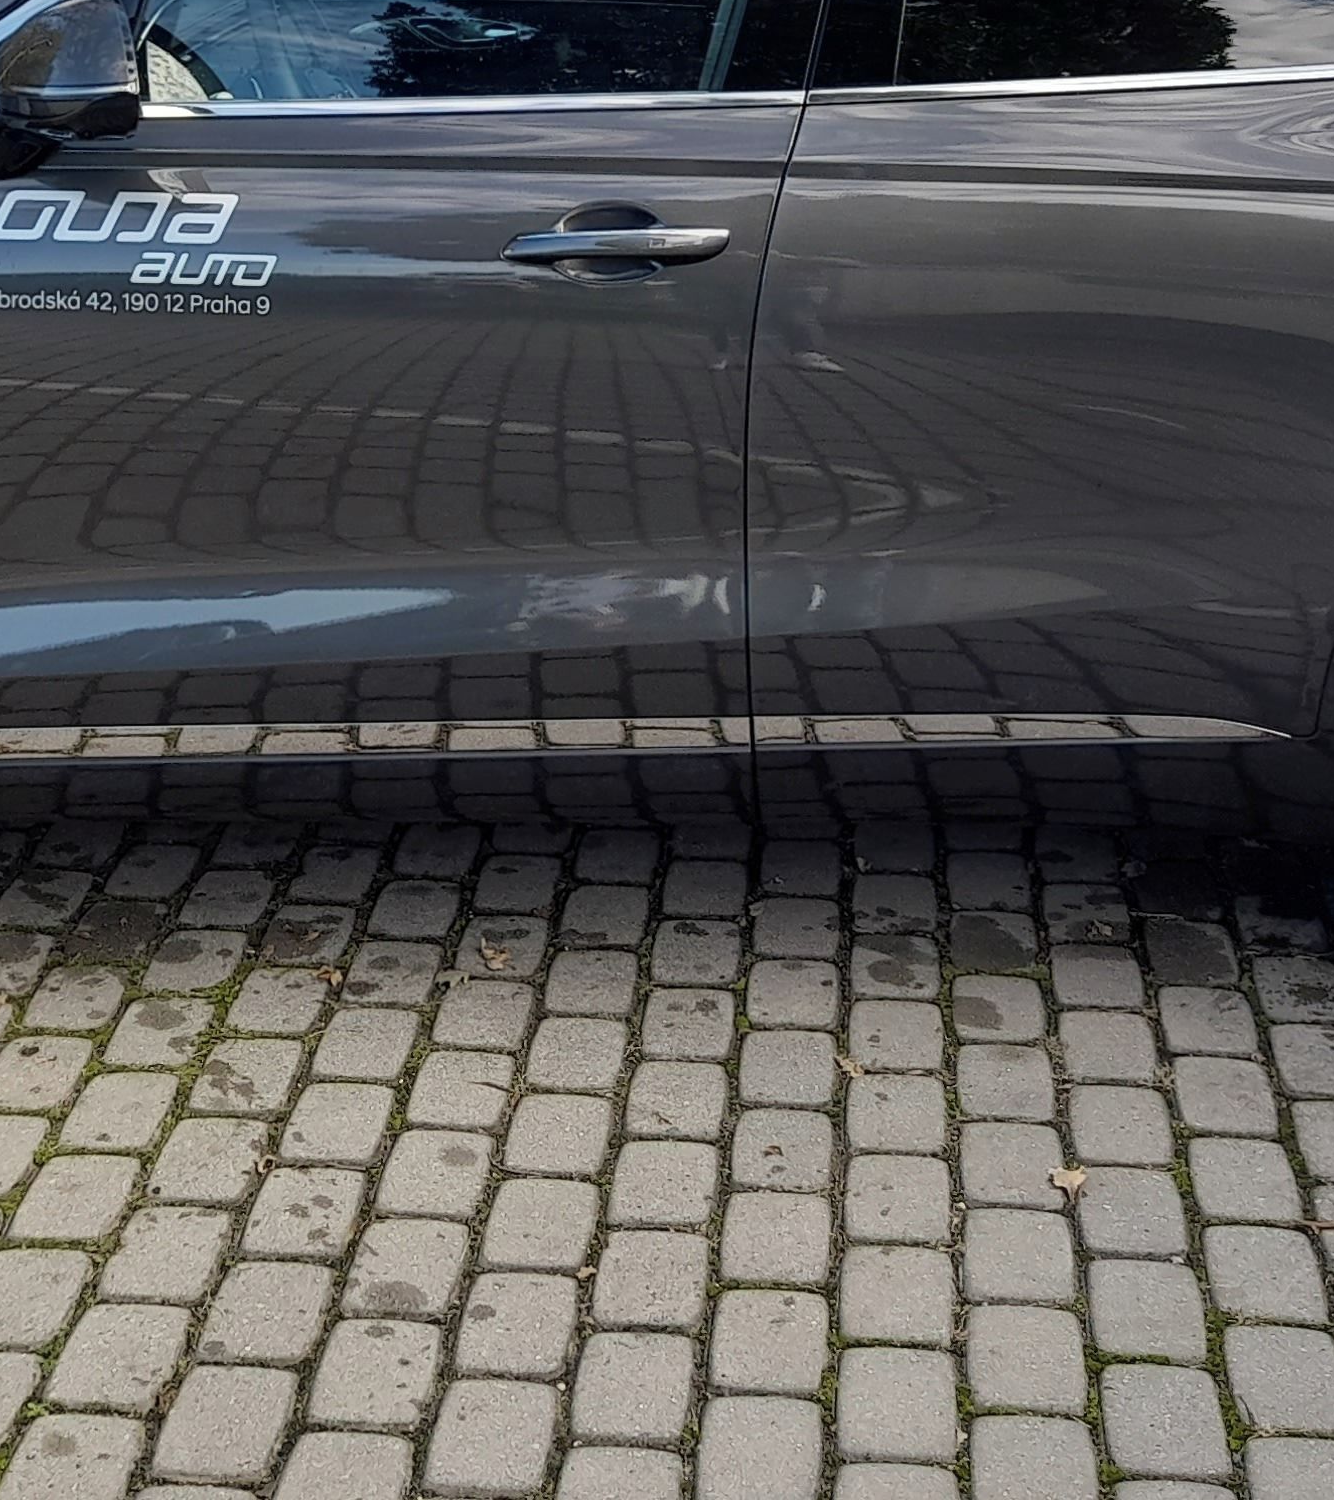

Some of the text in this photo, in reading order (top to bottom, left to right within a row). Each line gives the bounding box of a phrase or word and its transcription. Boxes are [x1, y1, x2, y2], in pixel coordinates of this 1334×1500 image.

[85, 292, 117, 314] 42,
[122, 293, 159, 312] 190
[164, 294, 184, 312] 12
[190, 295, 251, 314] Praha
[256, 296, 270, 315] 9
